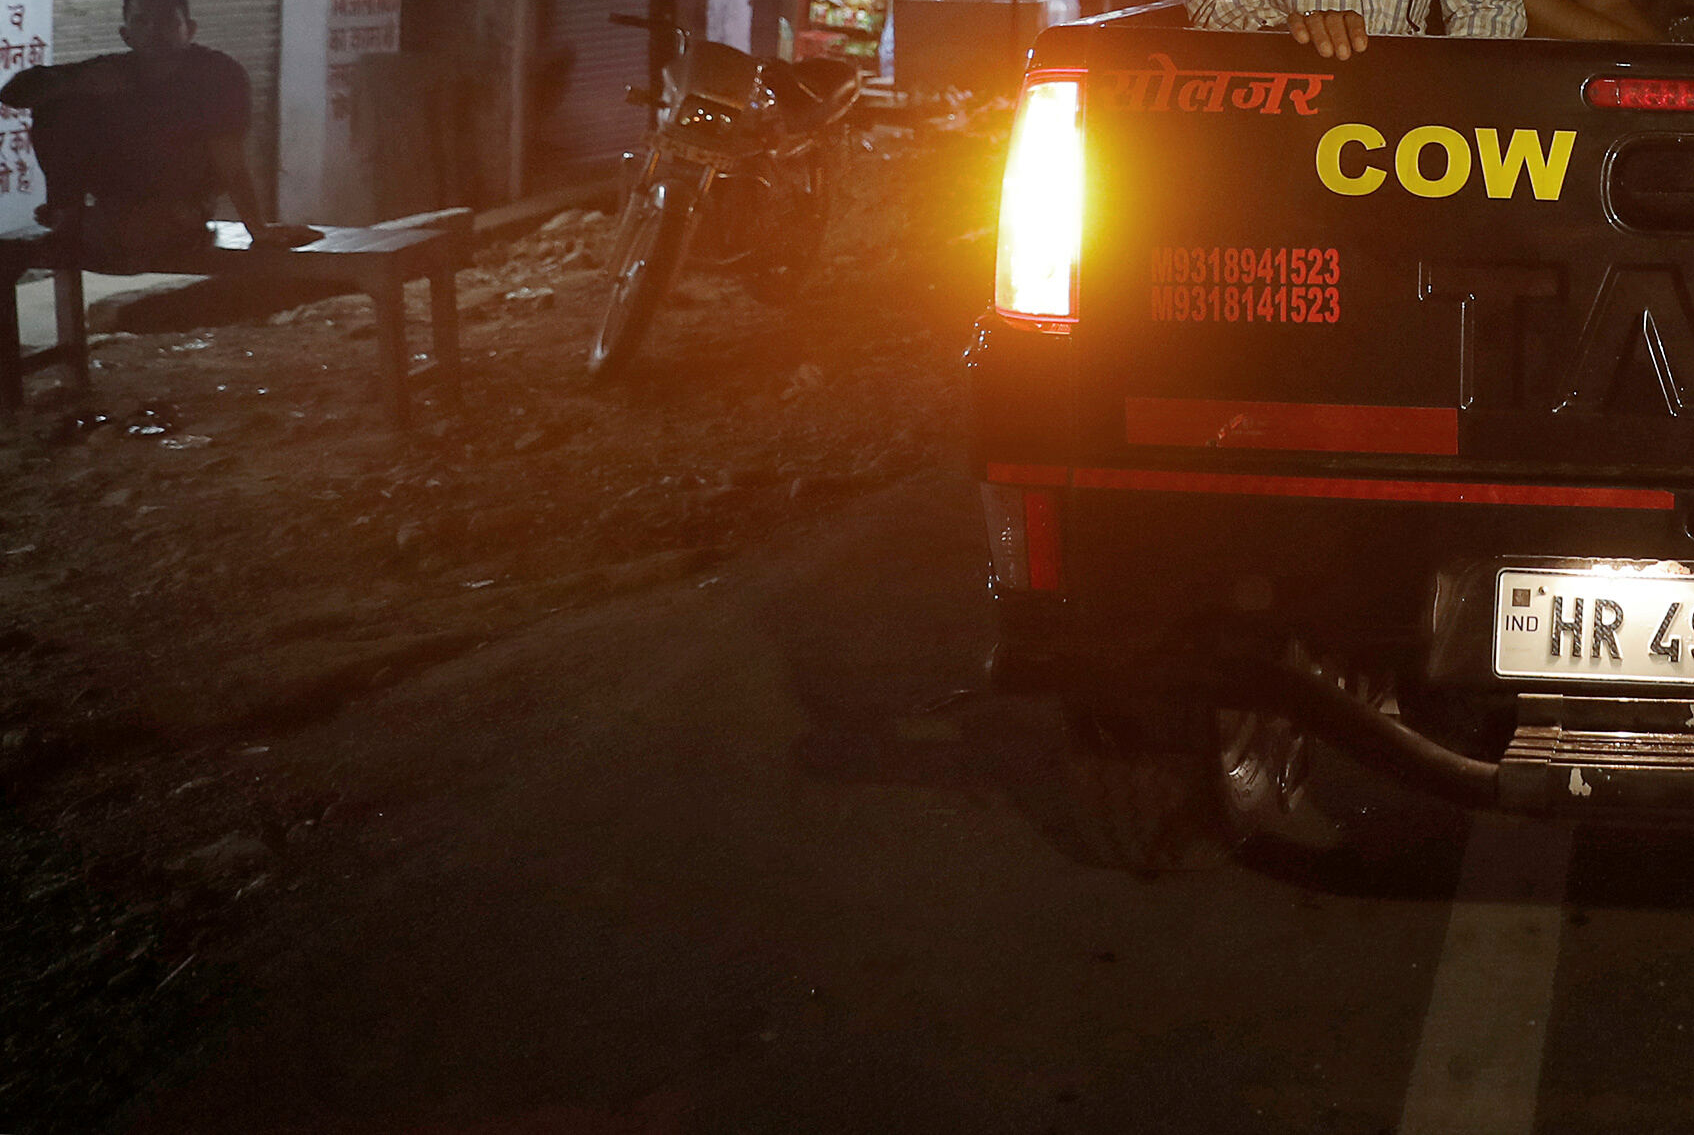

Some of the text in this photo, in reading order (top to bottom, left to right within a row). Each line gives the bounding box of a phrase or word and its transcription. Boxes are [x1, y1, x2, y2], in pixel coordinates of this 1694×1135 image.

[1316, 123, 1577, 201] COW
[1505, 614, 1539, 633] IND
[1550, 594, 1624, 660] HR
